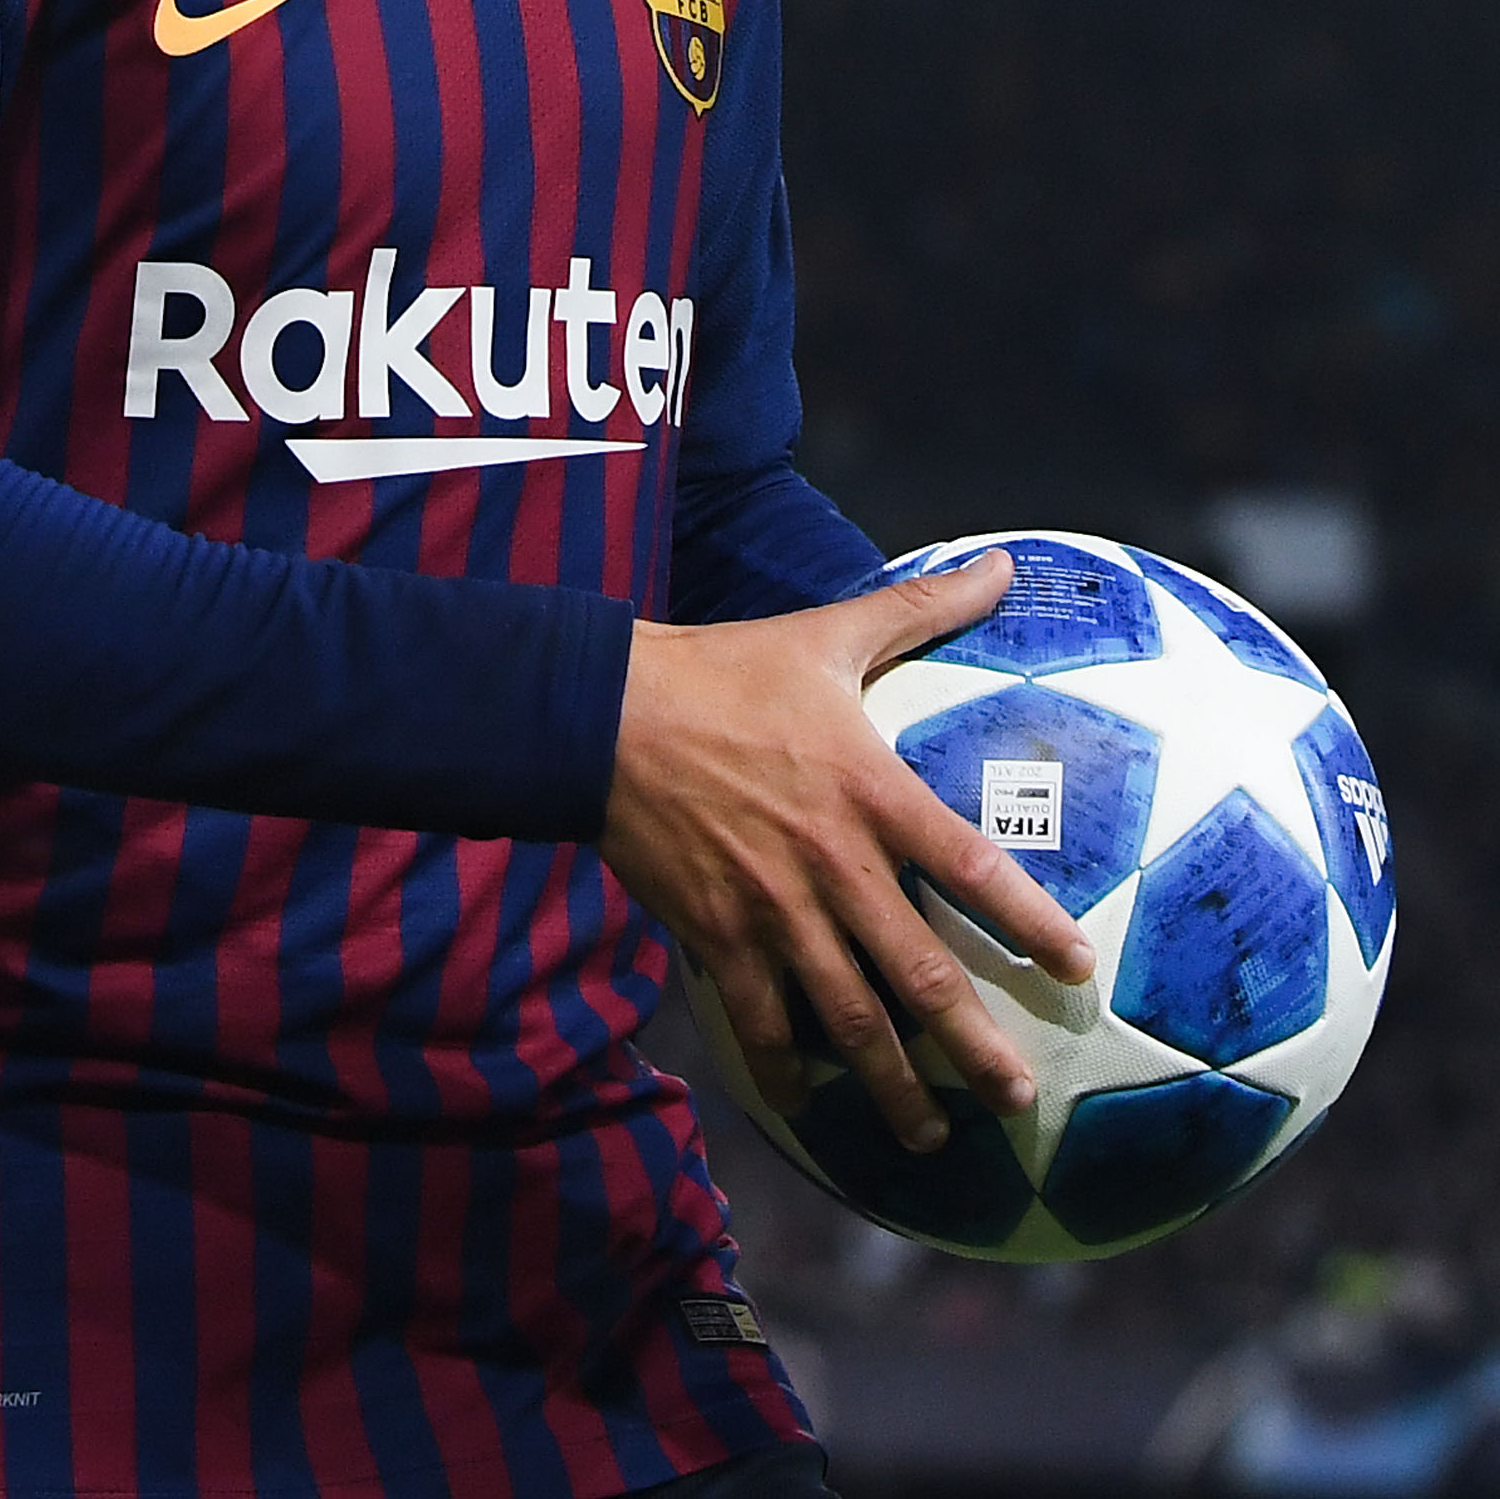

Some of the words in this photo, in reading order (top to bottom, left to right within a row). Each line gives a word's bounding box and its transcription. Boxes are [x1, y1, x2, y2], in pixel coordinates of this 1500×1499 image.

[124, 248, 694, 427] Rakuten
[995, 803, 1051, 814] QUALITY
[995, 816, 1049, 836] FIFA
